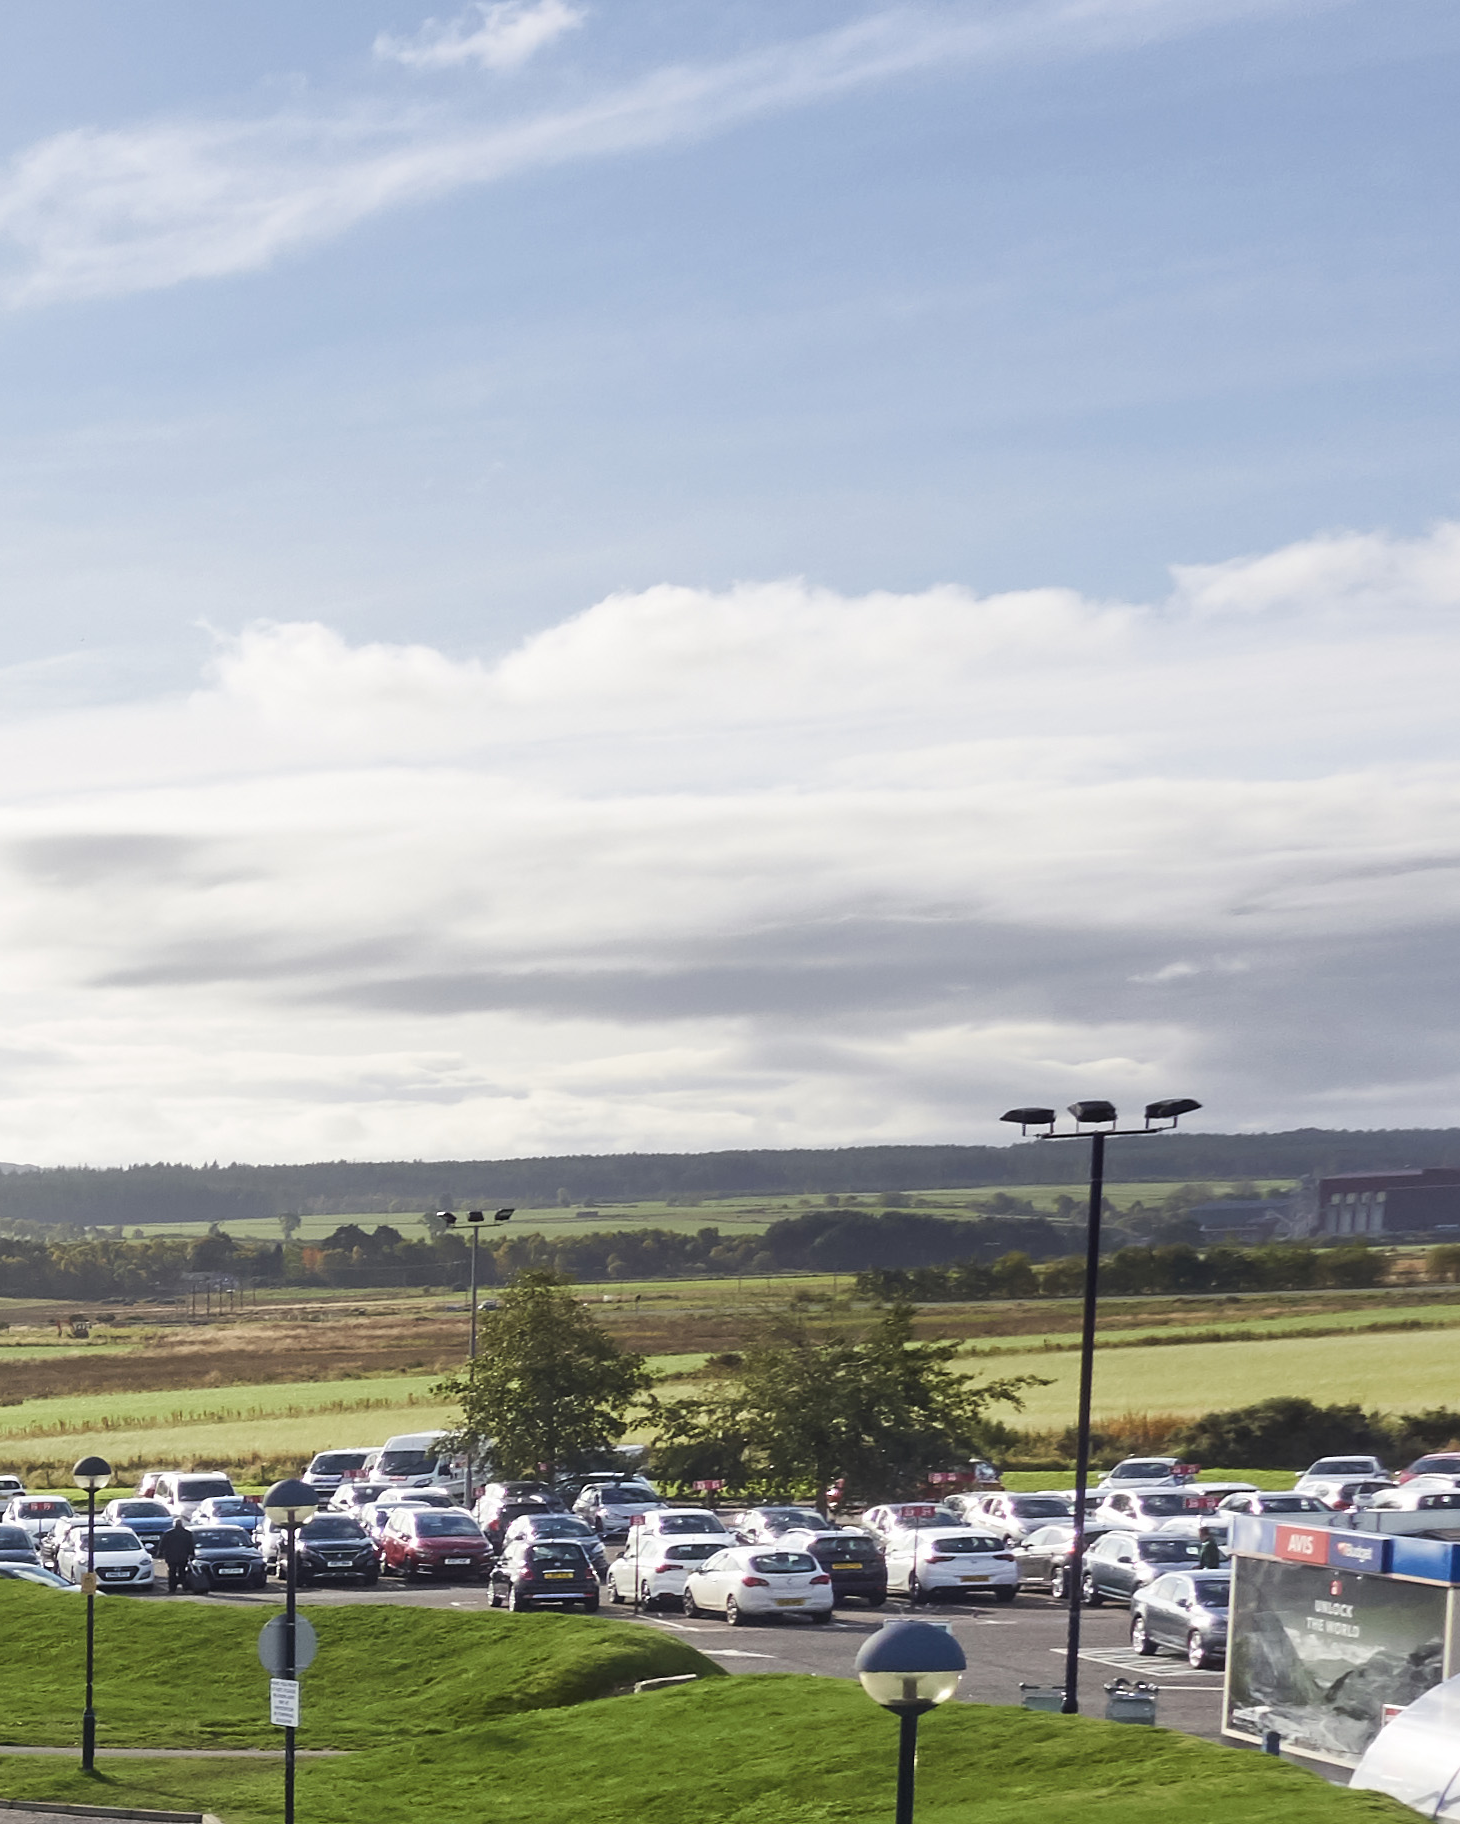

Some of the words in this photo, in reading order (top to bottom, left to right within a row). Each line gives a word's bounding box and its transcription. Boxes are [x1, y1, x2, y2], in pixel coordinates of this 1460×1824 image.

[1287, 1533, 1314, 1555] AVIS
[1314, 1599, 1354, 1618] UNLOCK
[1306, 1616, 1324, 1632] THE
[1326, 1620, 1360, 1639] WORLD
